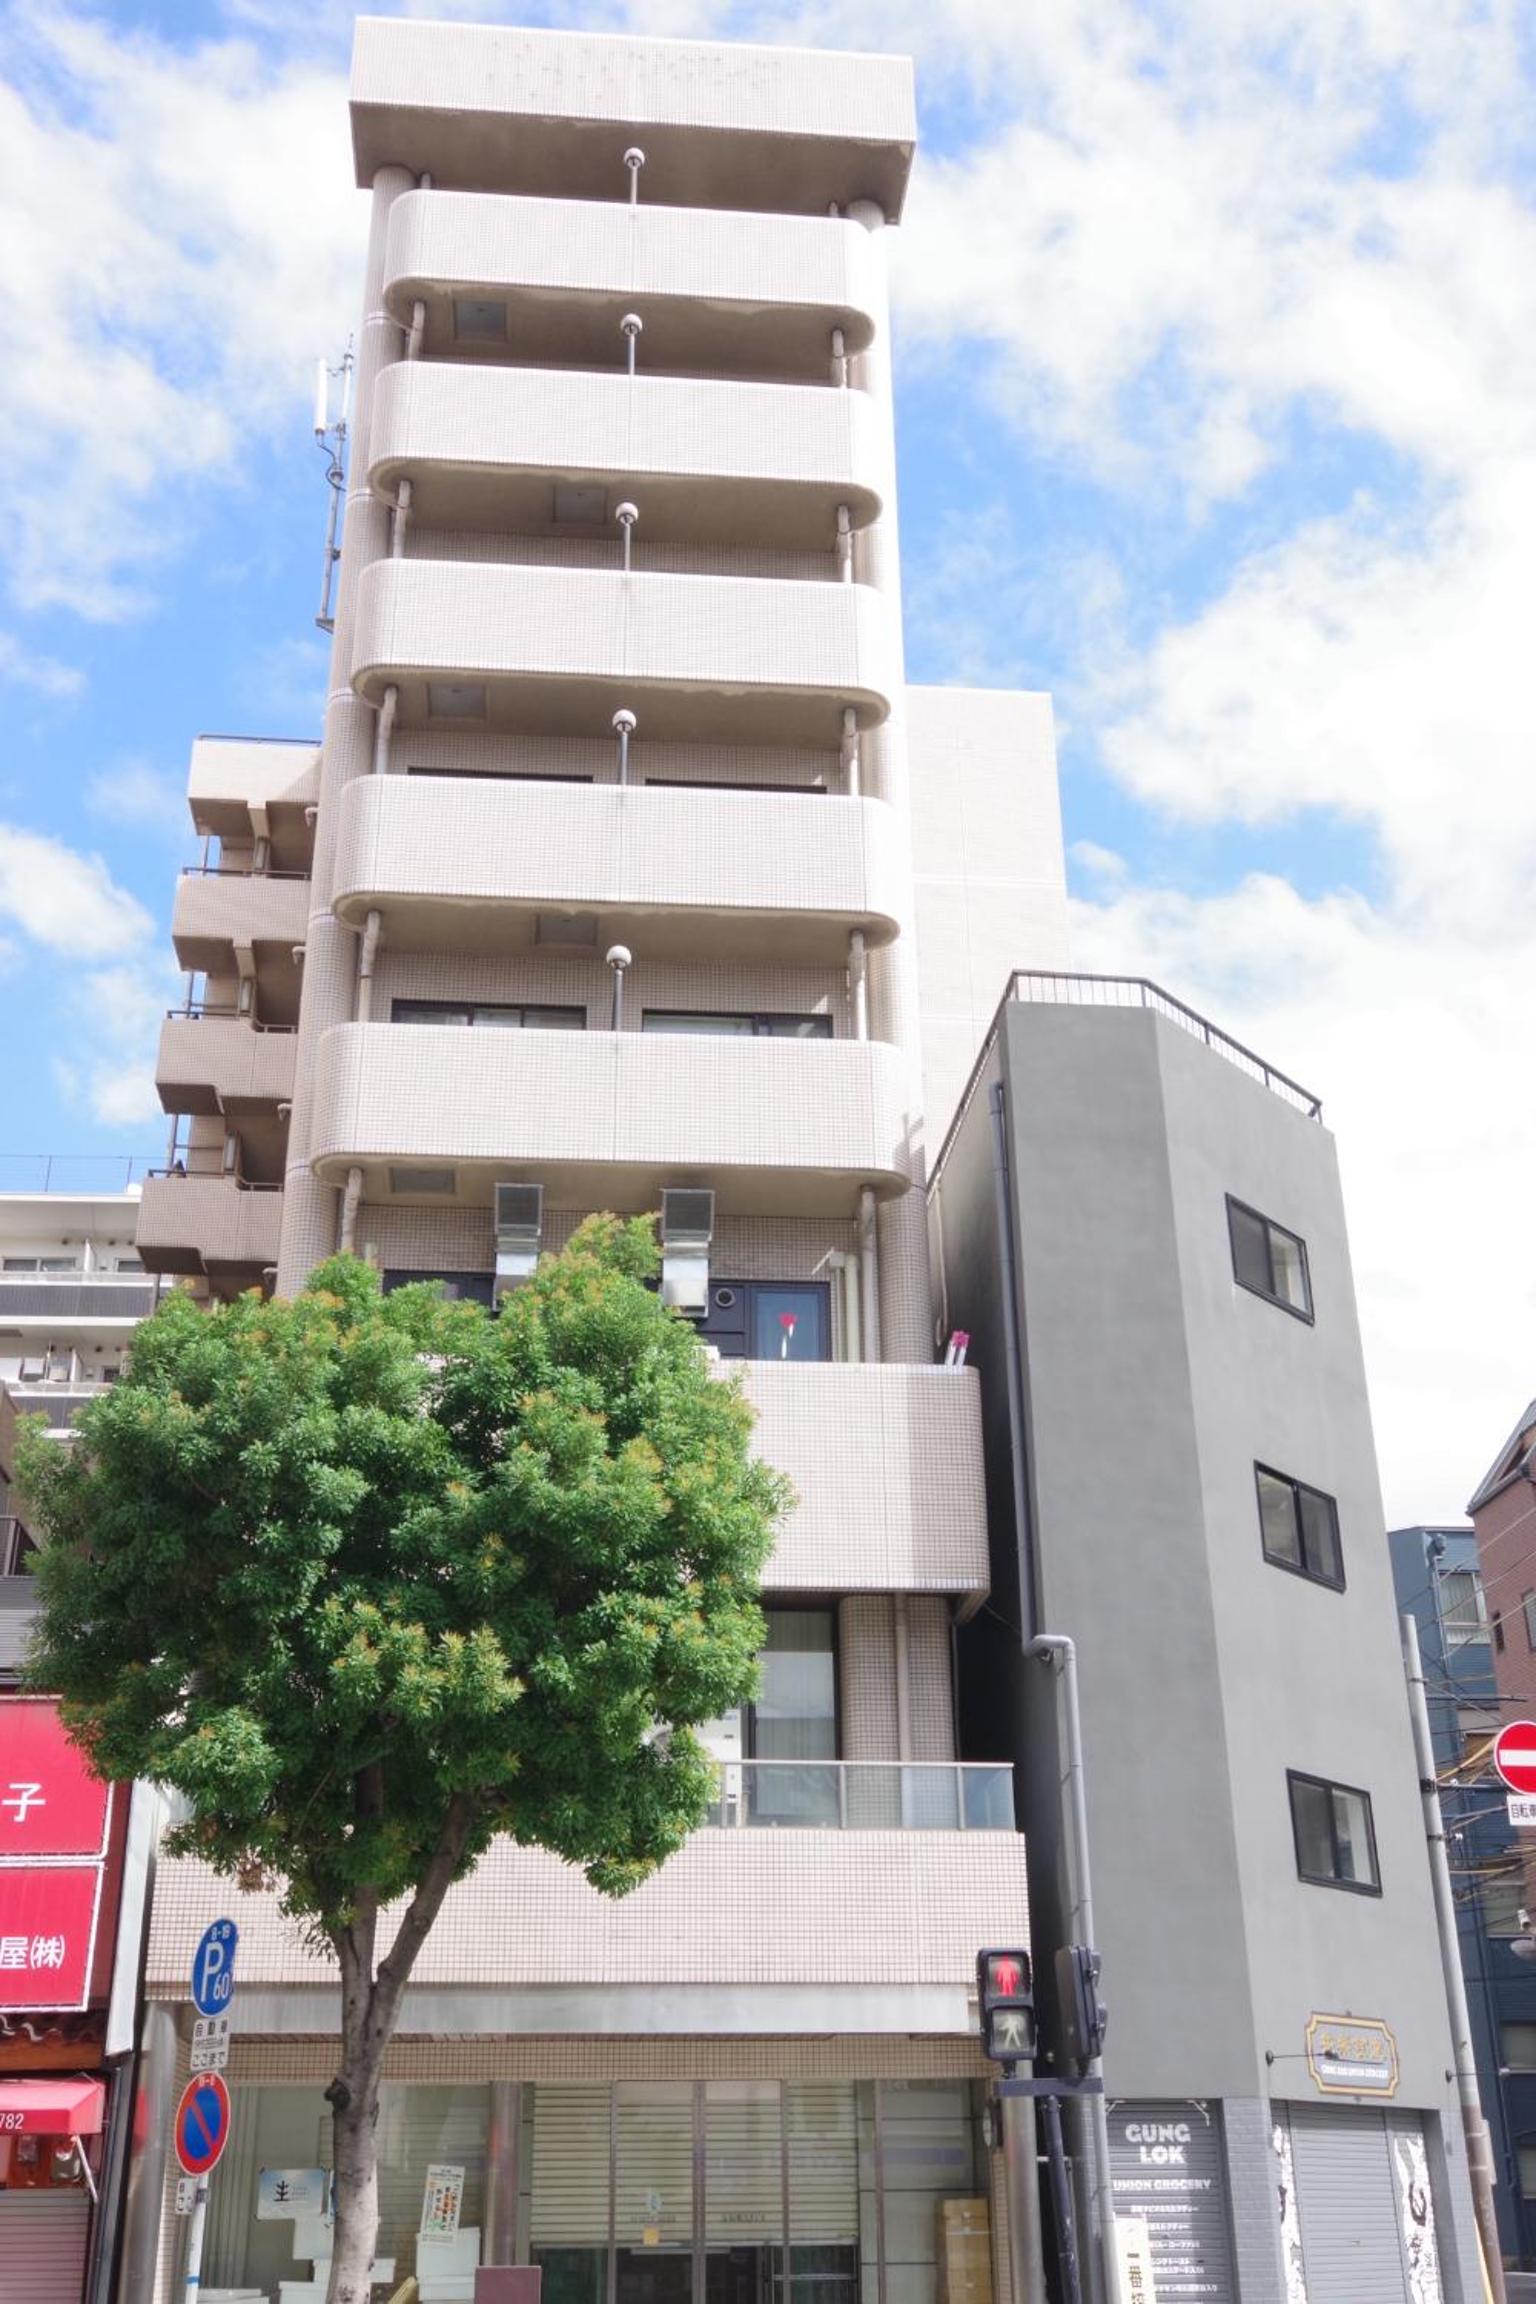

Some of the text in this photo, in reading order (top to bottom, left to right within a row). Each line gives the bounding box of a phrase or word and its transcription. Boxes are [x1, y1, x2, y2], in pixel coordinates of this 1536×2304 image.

[2, 1782, 46, 1822] 子
[201, 1942, 224, 2002] P
[213, 1972, 230, 2000] 60
[192, 2051, 225, 2067] ここまで
[1125, 2123, 1191, 2142] GUNG
[1140, 2145, 1187, 2164] LOK
[1113, 2179, 1211, 2191] UNION GROCERY
